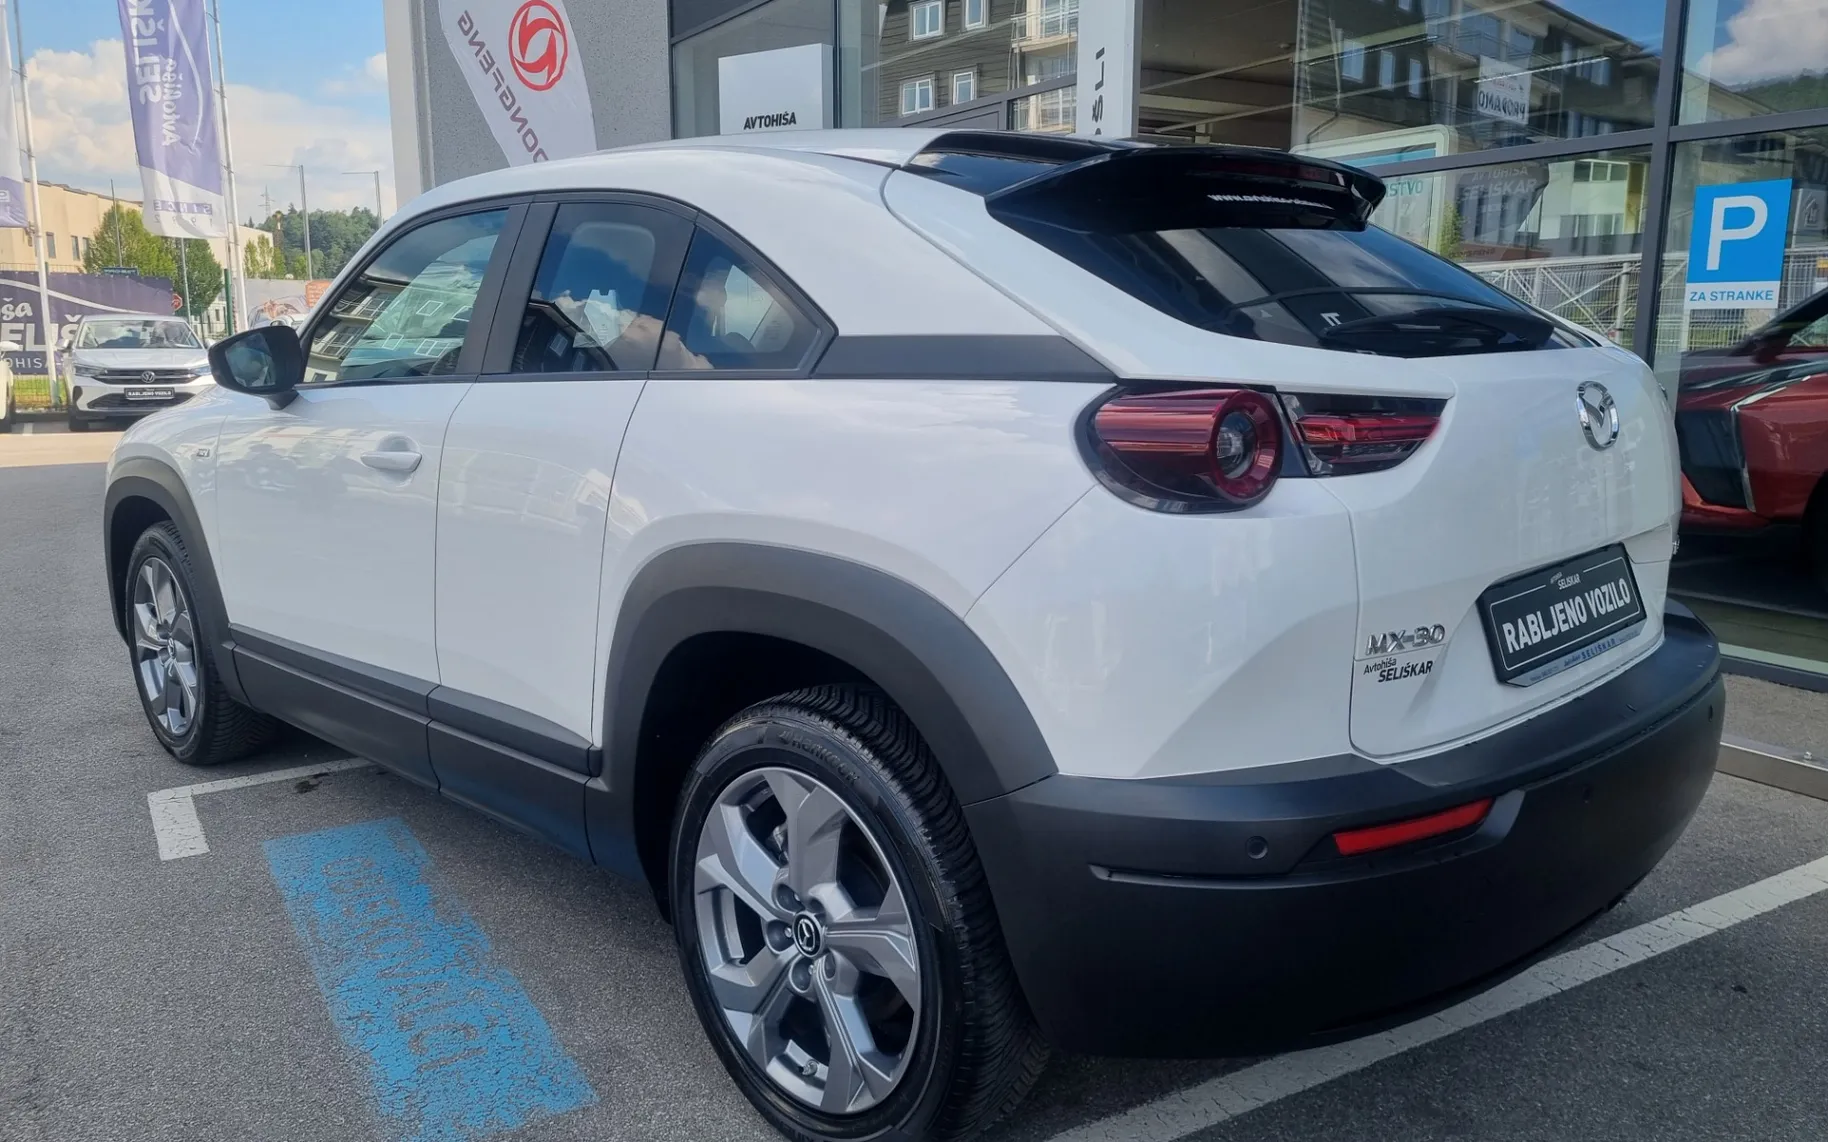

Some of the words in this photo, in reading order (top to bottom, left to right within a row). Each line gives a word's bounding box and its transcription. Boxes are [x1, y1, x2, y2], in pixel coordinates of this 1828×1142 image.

[743, 111, 797, 130] AVTOHIŠA
[1706, 195, 1768, 271] P
[1689, 291, 1707, 302] ZA
[1709, 290, 1774, 301] STRANKE
[1502, 595, 1588, 654] RABLJENO
[1584, 578, 1631, 618] VOZILO
[1365, 623, 1446, 656] MX-30
[1363, 657, 1397, 675] Avtohiša
[1377, 660, 1434, 683] SELIŠKAR
